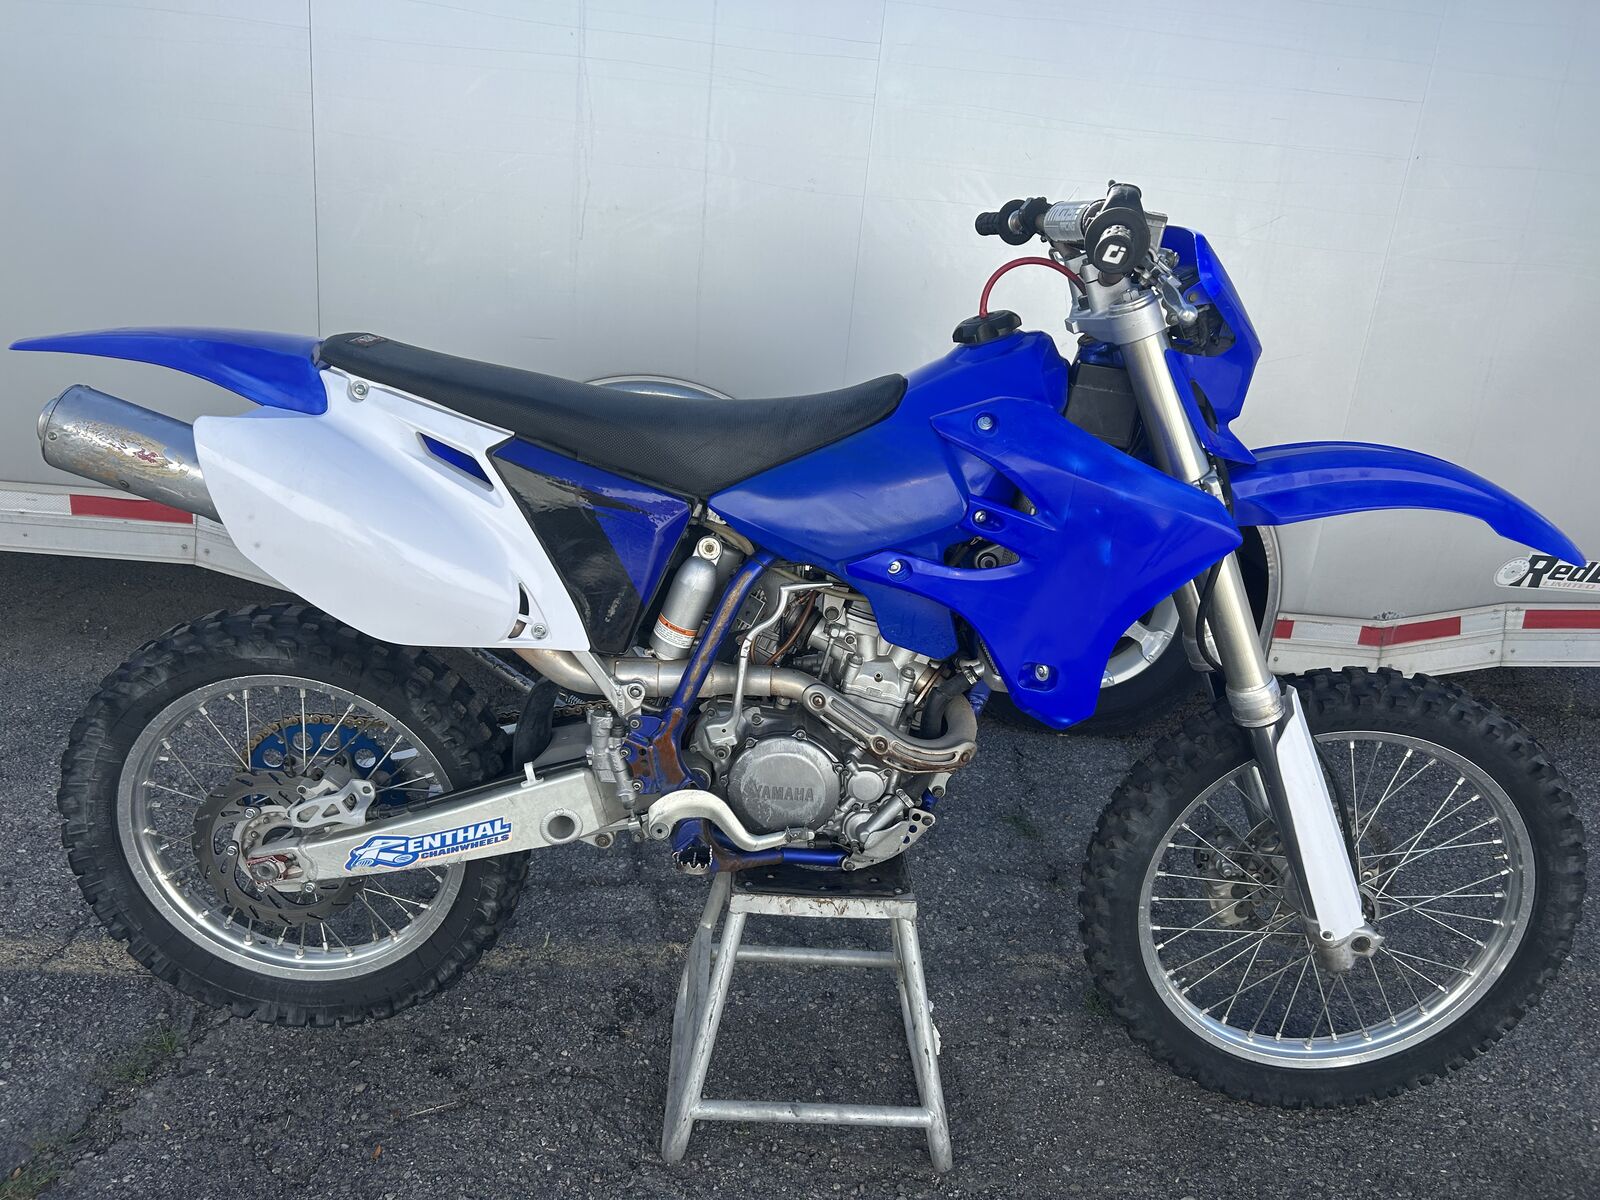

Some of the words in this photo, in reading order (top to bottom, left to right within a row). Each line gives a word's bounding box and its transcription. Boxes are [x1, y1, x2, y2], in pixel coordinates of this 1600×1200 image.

[755, 785, 814, 801] YAMAHA
[347, 819, 511, 868] RENTHAL
[420, 833, 510, 859] CHAINWHEELS
